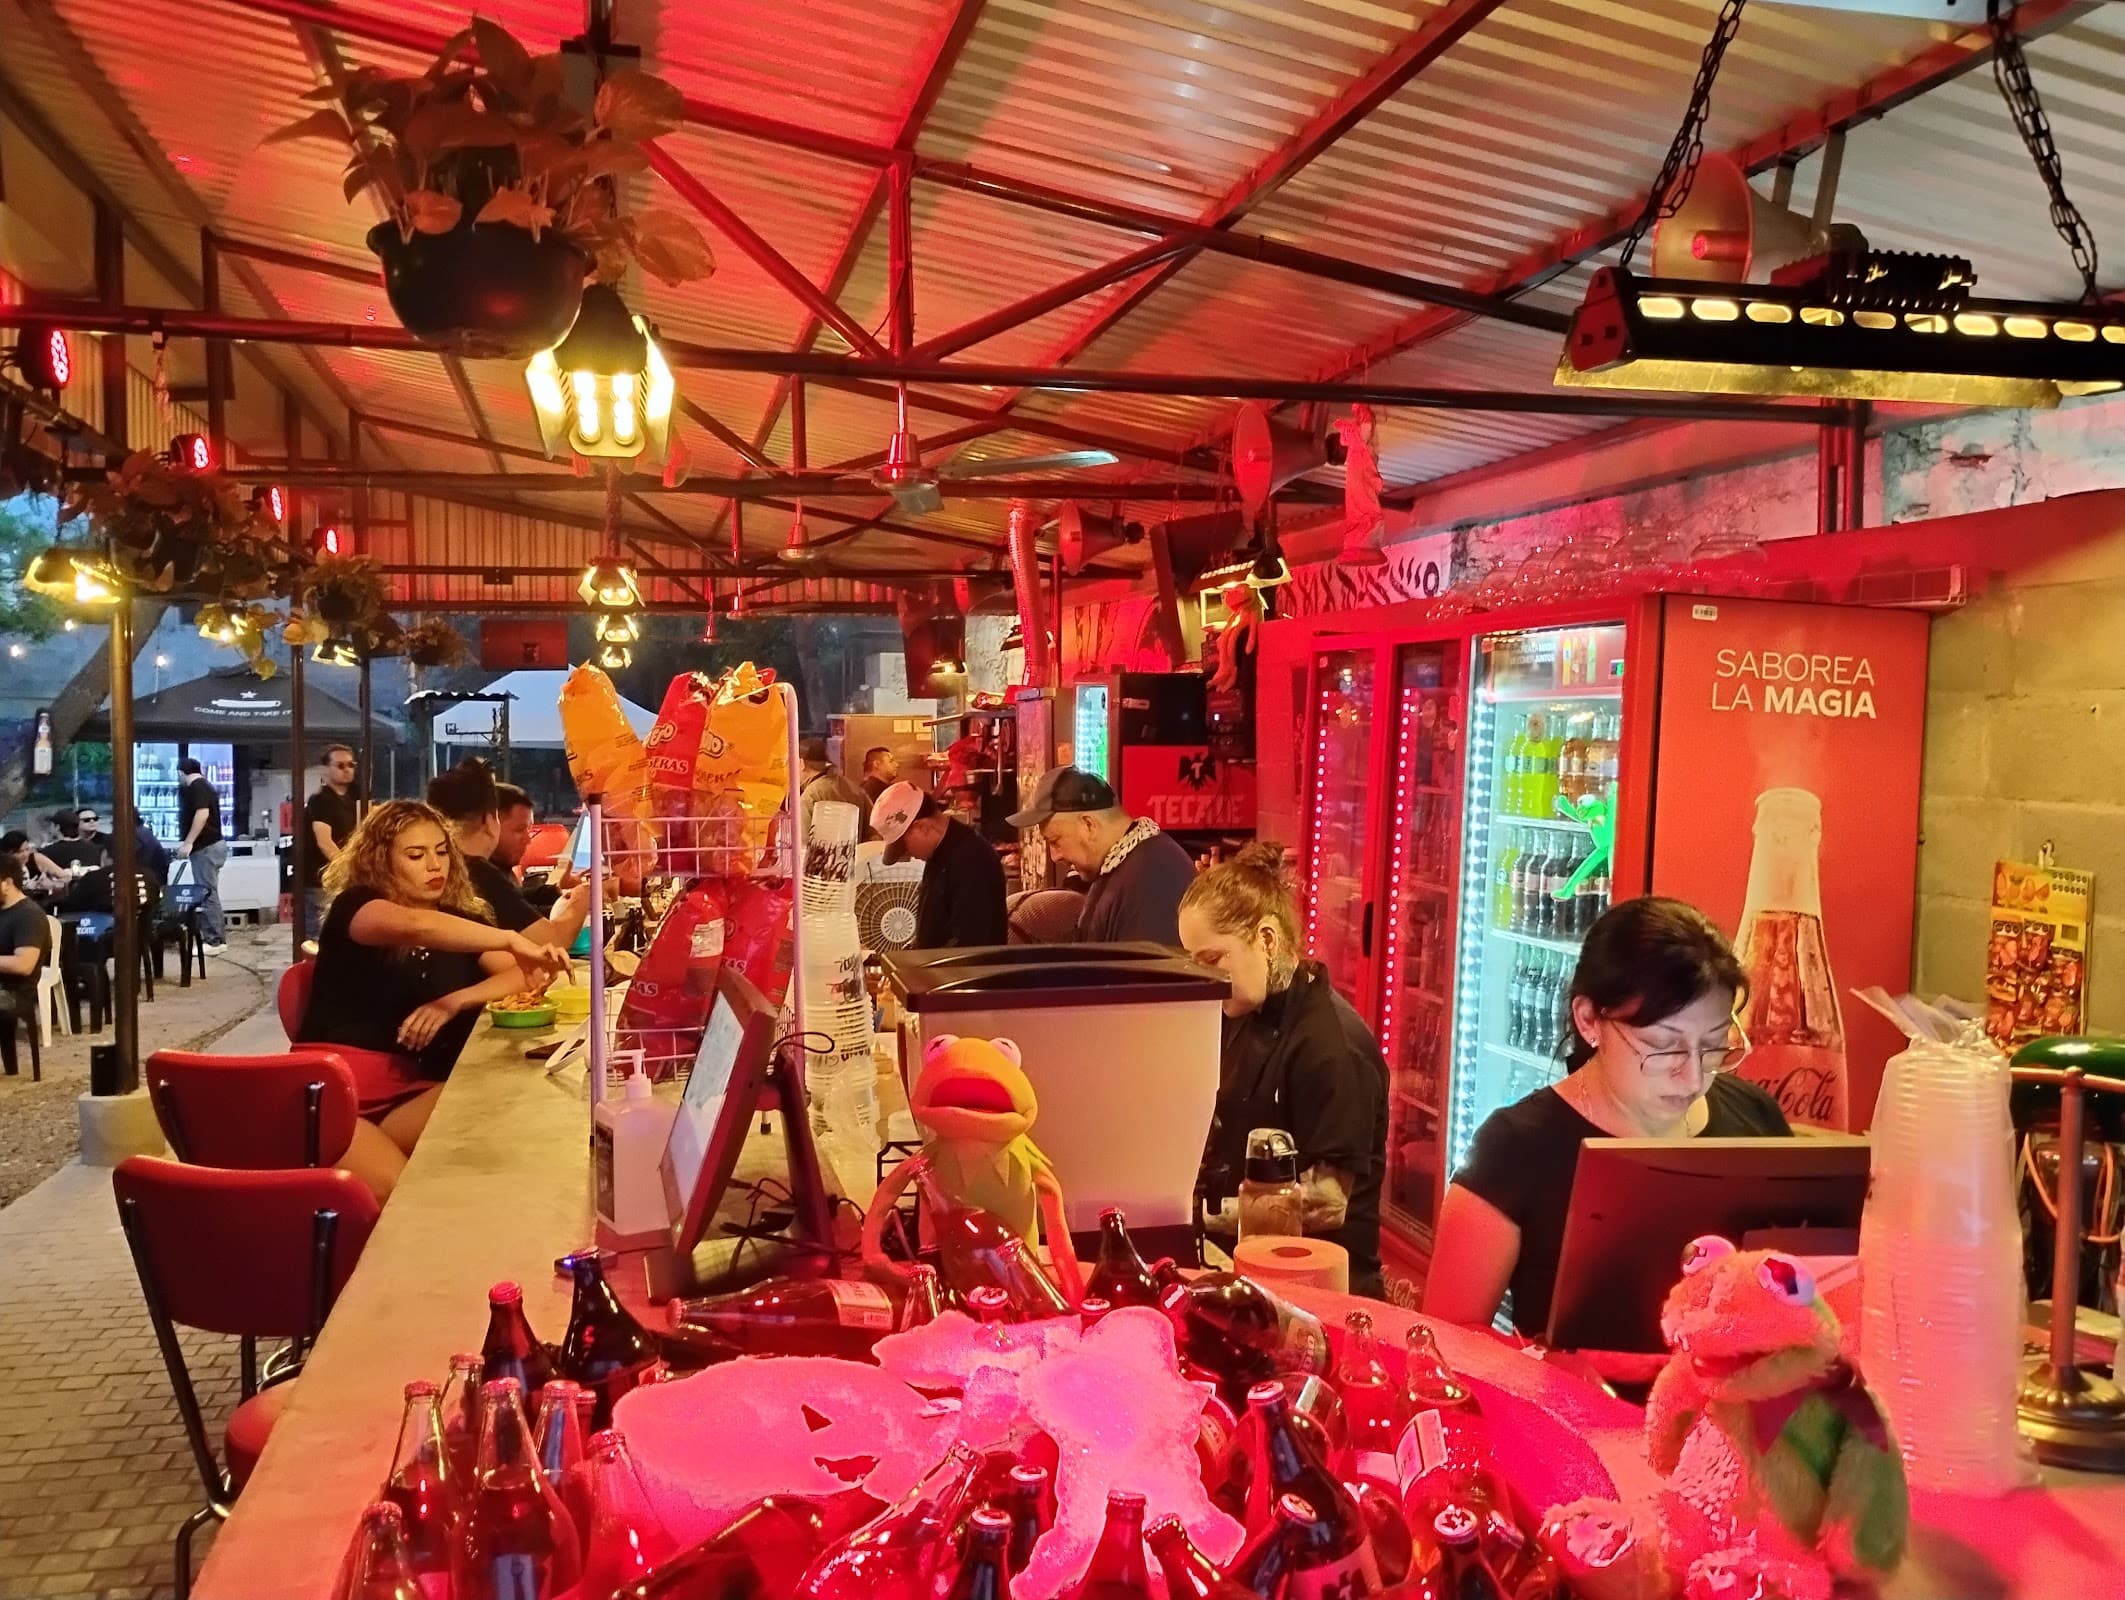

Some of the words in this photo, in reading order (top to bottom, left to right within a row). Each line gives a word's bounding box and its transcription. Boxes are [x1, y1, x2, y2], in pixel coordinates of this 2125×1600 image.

[1715, 648, 1876, 687] SABOREA
[193, 706, 226, 716] COME
[1711, 681, 1755, 713] LA
[1763, 684, 1878, 720] MAGIA
